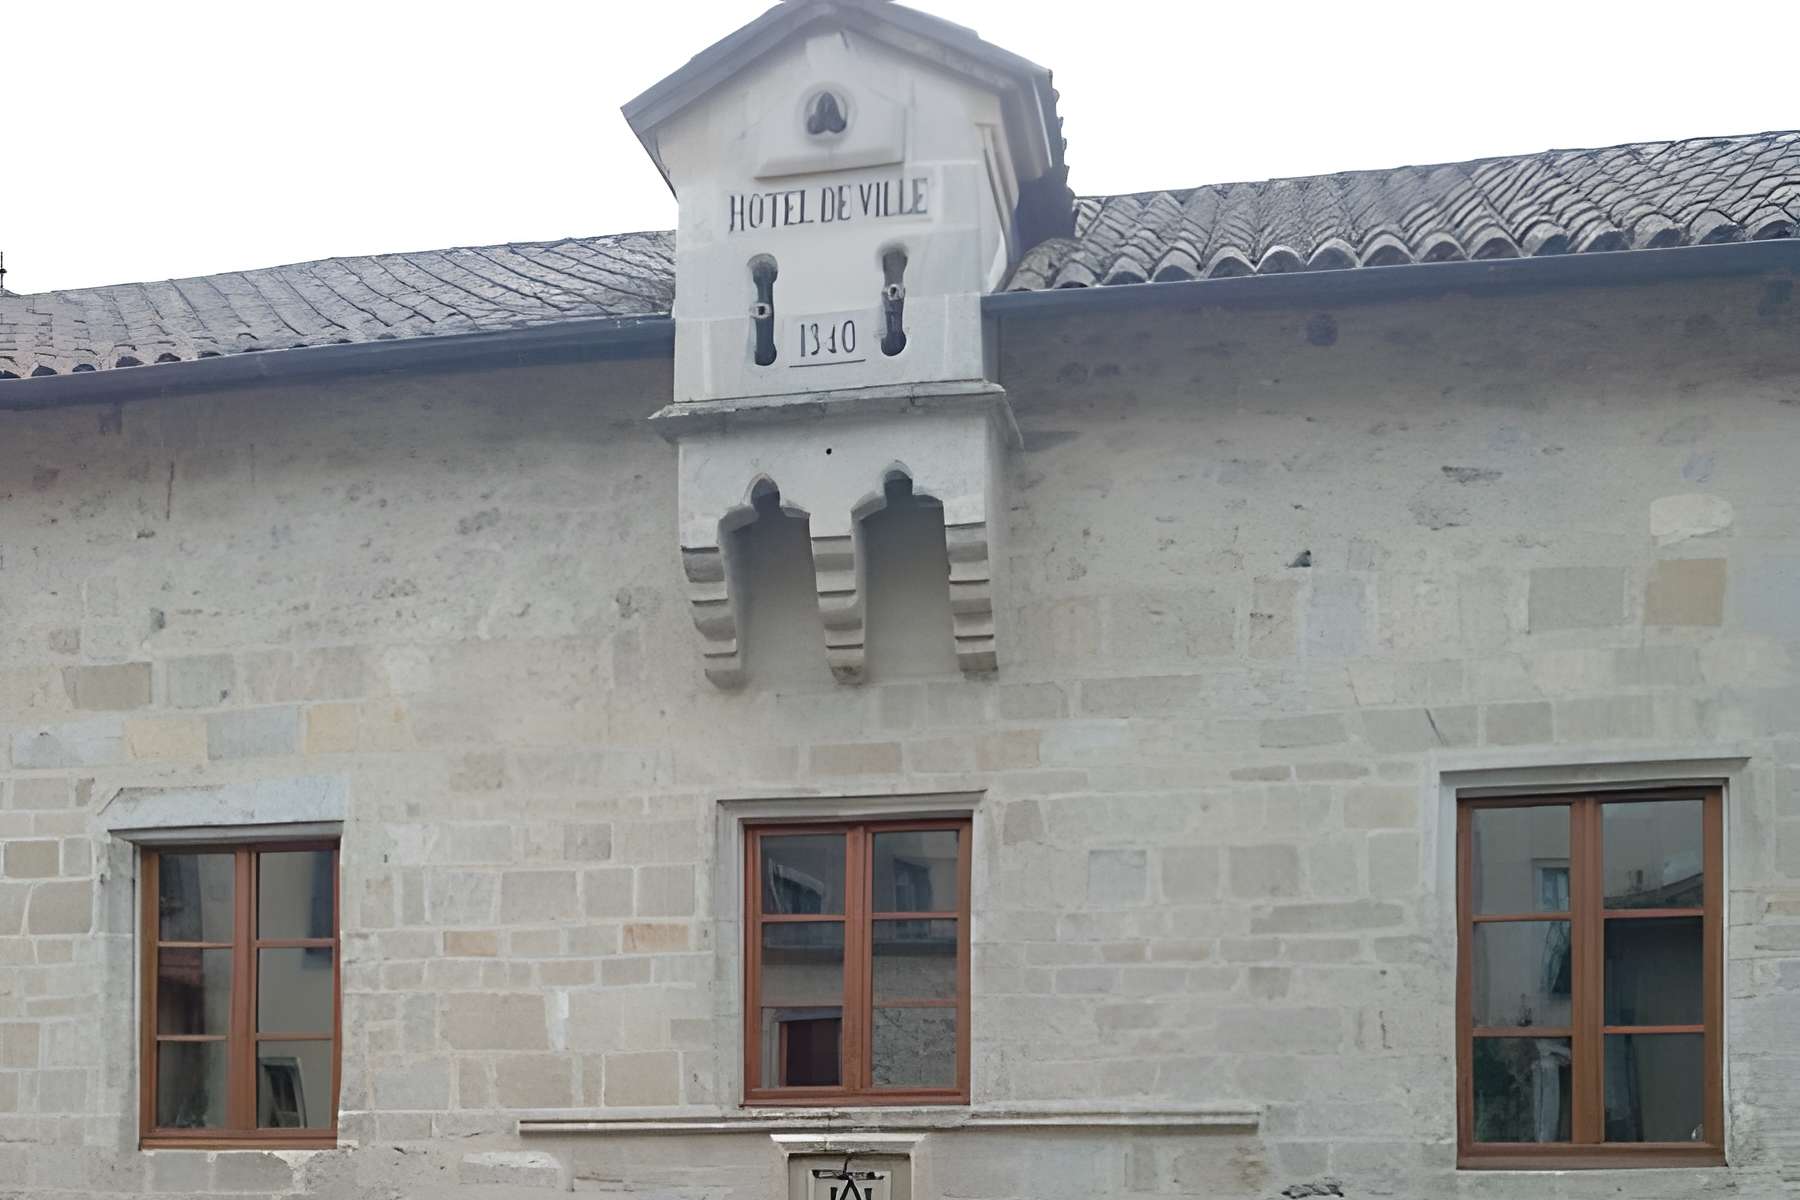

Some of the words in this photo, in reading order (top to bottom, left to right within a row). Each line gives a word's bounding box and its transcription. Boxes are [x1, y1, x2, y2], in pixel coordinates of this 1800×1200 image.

[729, 190, 814, 232] HOTEL
[820, 184, 851, 223] DE
[859, 178, 928, 217] VILLE
